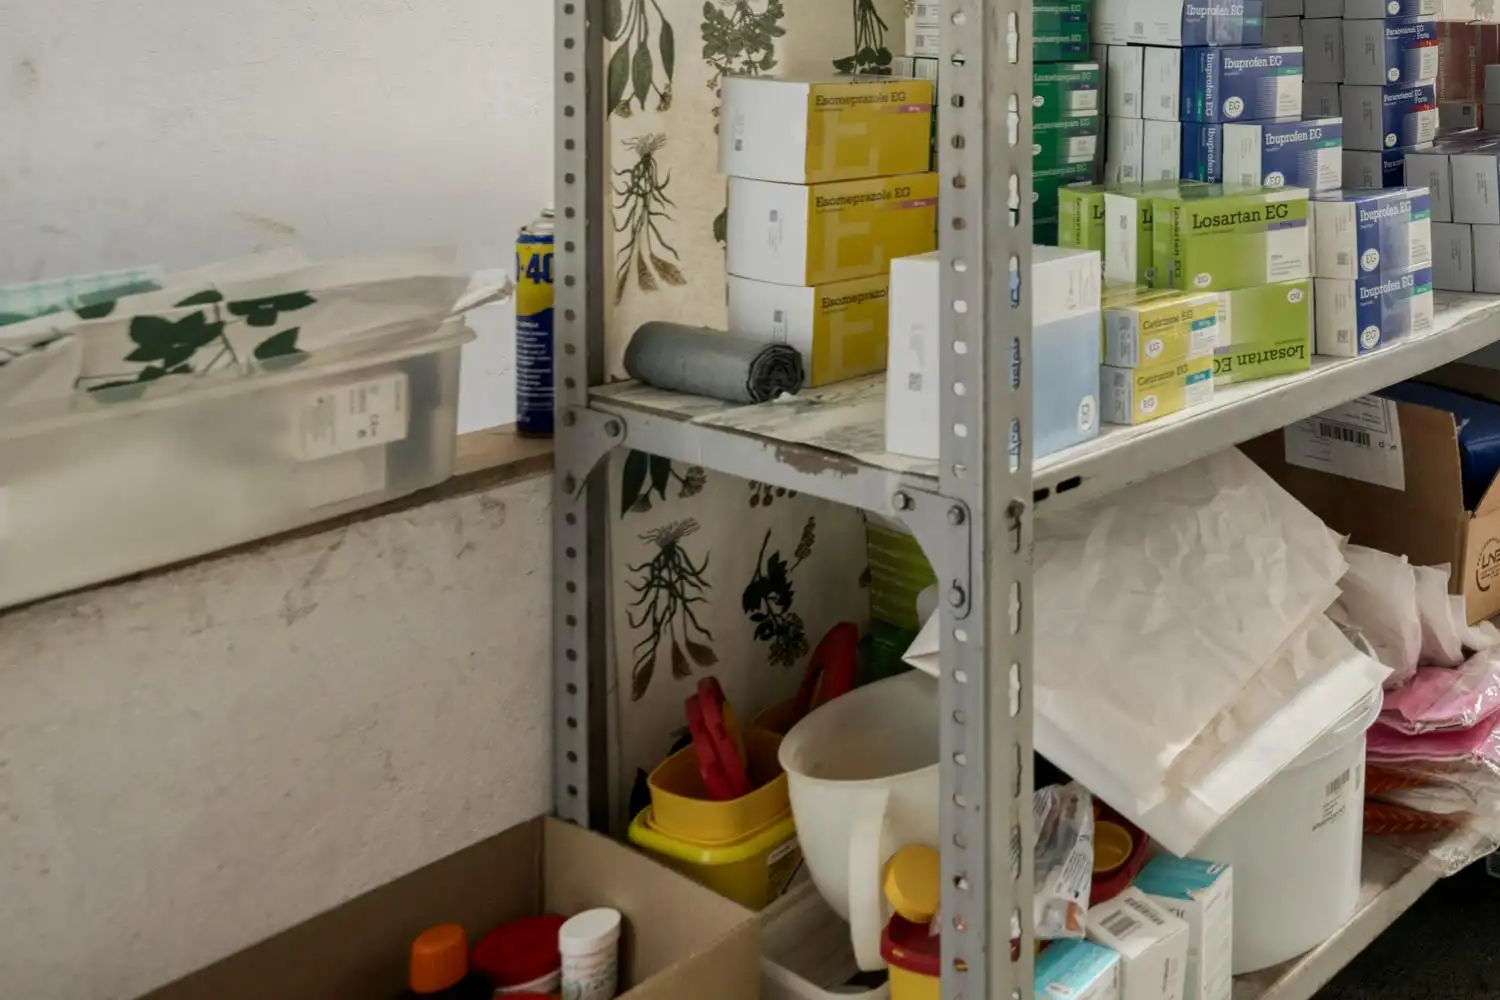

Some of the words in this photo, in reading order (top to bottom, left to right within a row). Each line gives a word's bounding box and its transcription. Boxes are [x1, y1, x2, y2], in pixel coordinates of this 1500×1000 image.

[1186, 4, 1229, 18] Ibuprofen
[1231, 4, 1244, 16] EG
[1224, 57, 1267, 71] Ibuprofen
[1269, 55, 1283, 66] EG
[815, 91, 889, 108] Esomeprazole
[890, 91, 907, 102] EG
[1228, 102, 1241, 111] EG
[1265, 131, 1308, 147] Ibuprofen
[1309, 128, 1322, 140] EG
[1207, 176, 1215, 184] E
[815, 190, 892, 208] Esomeprazole
[894, 187, 911, 199] EG
[1192, 208, 1262, 230] Losartan
[1265, 203, 1289, 220] EG
[1360, 204, 1399, 223] Ibuprofen
[1400, 200, 1412, 213] EG
[1360, 279, 1400, 299] Ibuprofen
[1401, 274, 1413, 287] EG
[821, 285, 888, 309] Esomeprazol
[1238, 344, 1305, 362] Losartan
